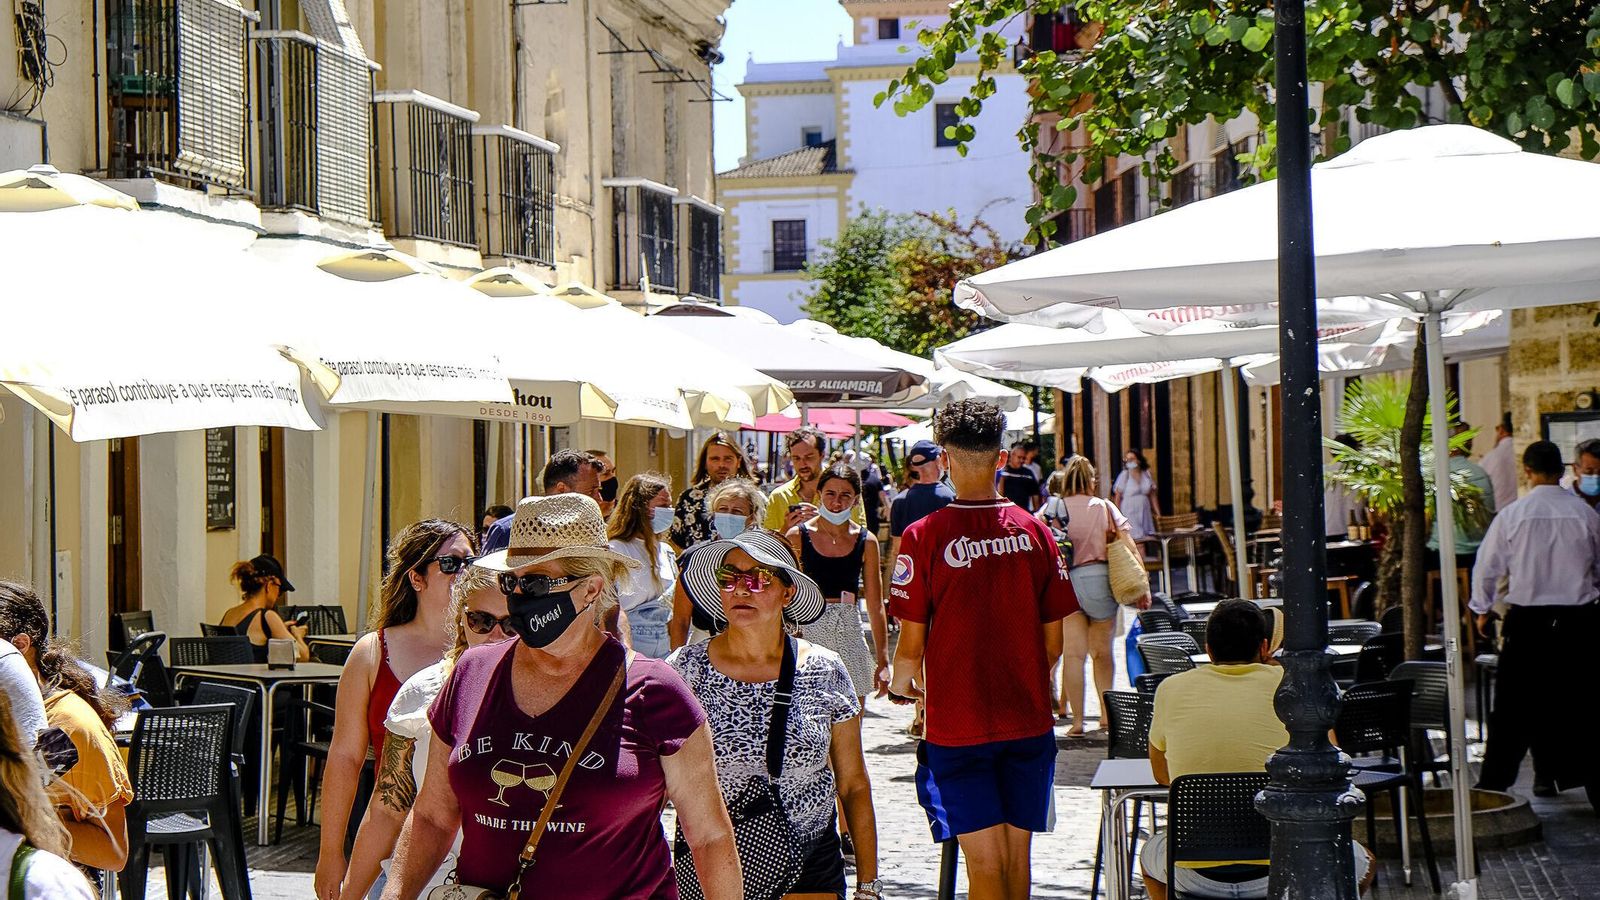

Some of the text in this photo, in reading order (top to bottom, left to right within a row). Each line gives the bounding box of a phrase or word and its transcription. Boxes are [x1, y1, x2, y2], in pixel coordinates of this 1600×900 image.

[404, 363, 410, 376] a
[411, 364, 426, 380] que
[79, 380, 119, 412] parasol
[120, 379, 179, 404] contribuye
[179, 383, 189, 399] a
[188, 383, 211, 403] que
[210, 379, 252, 403] respires
[252, 379, 274, 399] más
[273, 381, 299, 406] limpio
[819, 380, 883, 394] ALHAMBRA
[480, 407, 551, 422] DESDE 1890
[944, 533, 1033, 568] Corona
[529, 603, 562, 632] Cheers!
[457, 736, 492, 762] BE
[474, 813, 507, 830] SHARE
[546, 821, 586, 833] WINE
